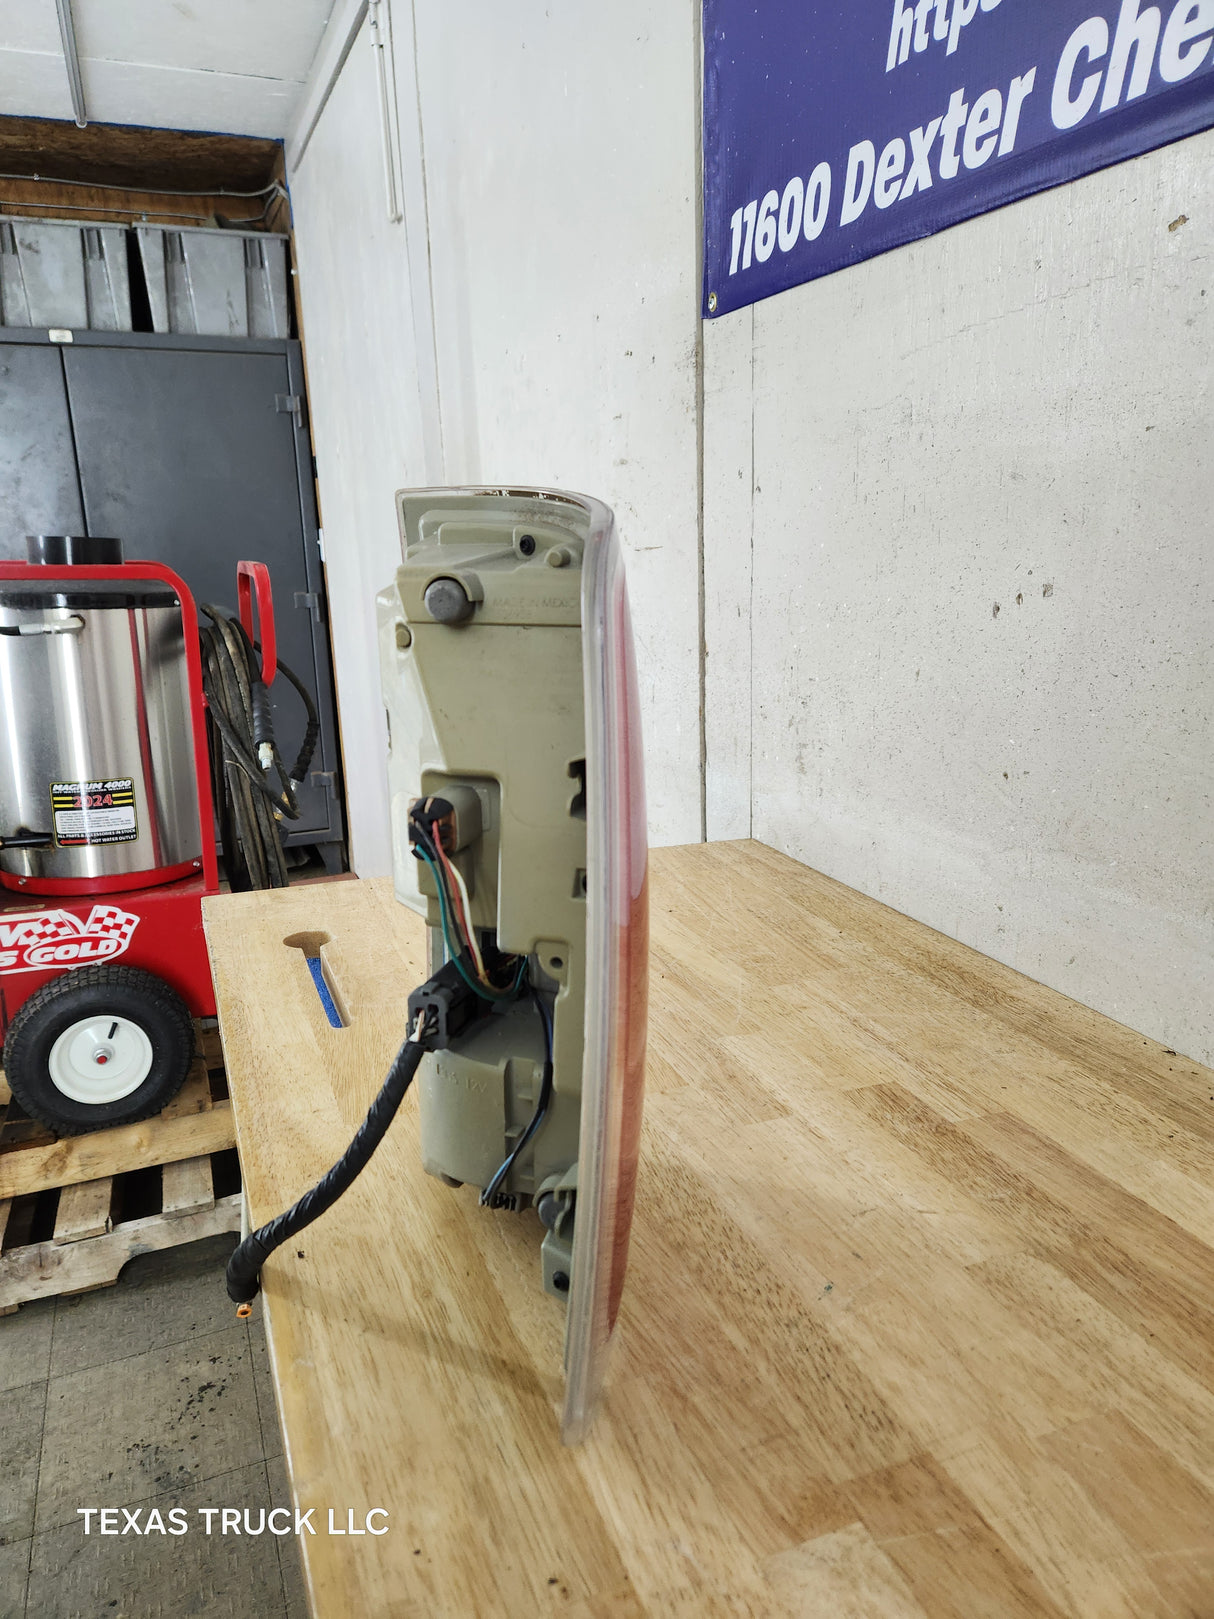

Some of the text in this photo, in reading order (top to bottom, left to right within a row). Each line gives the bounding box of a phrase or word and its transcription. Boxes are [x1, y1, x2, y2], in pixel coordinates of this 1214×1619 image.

[886, 0, 1002, 73] http
[729, 0, 1214, 276] 11600 Dexter Che
[104, 780, 131, 789] 4000
[73, 794, 113, 808] 2024
[30, 939, 118, 963] GOLD
